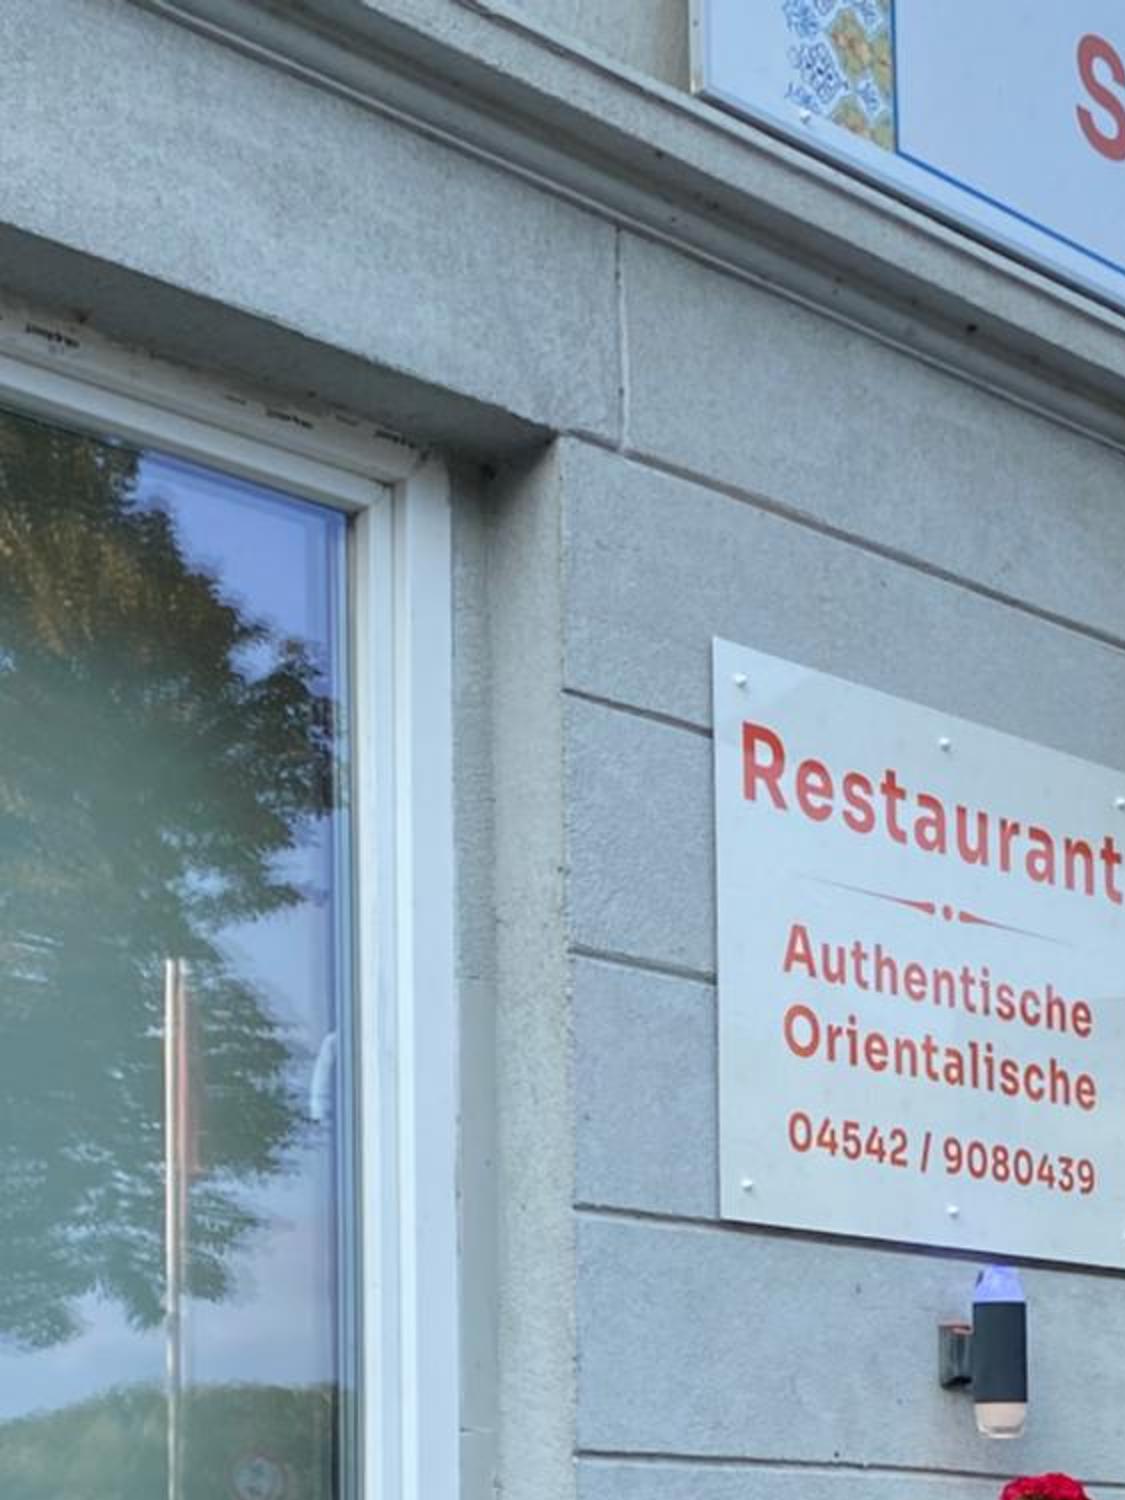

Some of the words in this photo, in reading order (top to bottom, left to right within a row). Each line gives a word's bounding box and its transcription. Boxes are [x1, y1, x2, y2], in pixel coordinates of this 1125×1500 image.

[740, 719, 1124, 905] Restaurant
[782, 923, 1093, 1039] Authentische
[782, 1003, 1097, 1111] Orientalische
[787, 1110, 909, 1168] 04542
[919, 1132, 932, 1172] /
[943, 1135, 1096, 1195] 9080439
